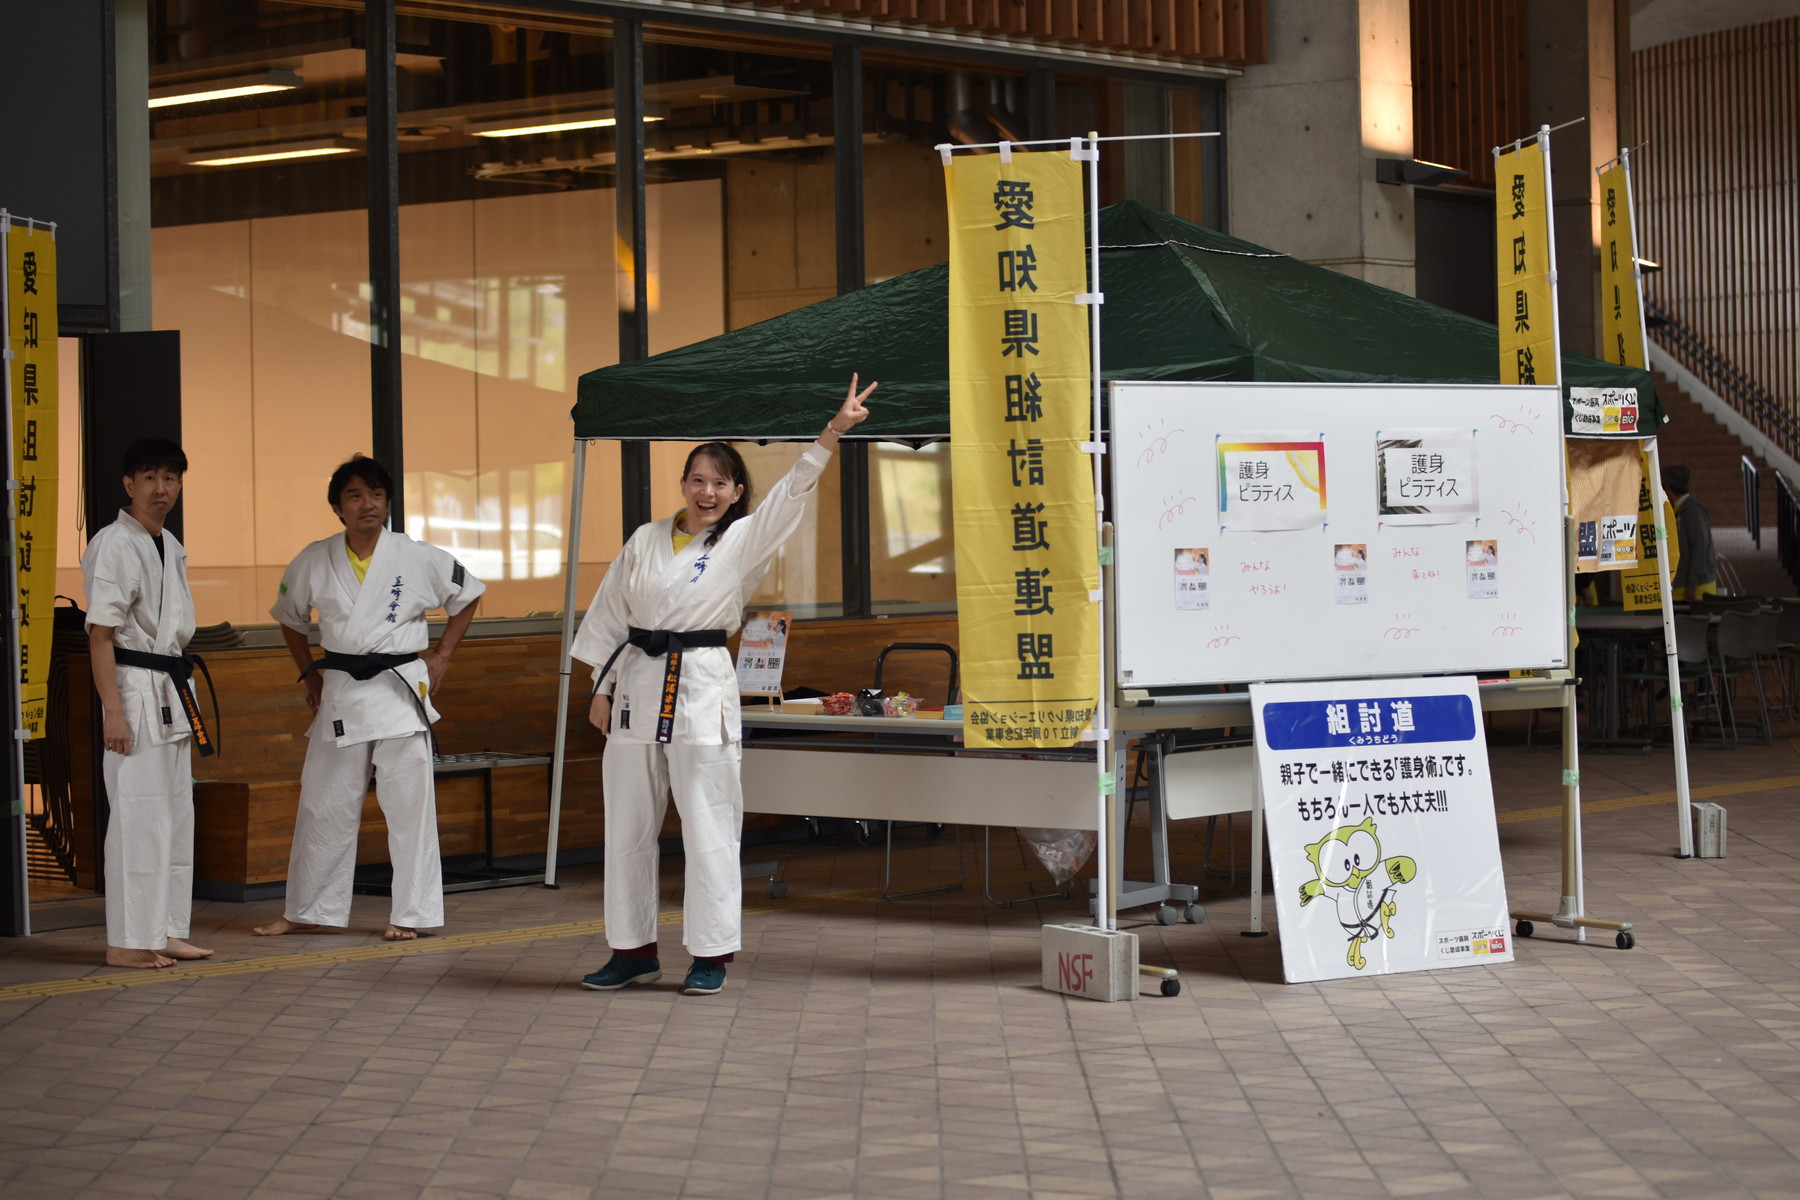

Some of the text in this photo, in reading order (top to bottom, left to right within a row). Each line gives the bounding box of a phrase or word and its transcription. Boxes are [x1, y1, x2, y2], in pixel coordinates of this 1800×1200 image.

[1239, 461, 1269, 480] 護身
[1412, 453, 1445, 475] 護身
[1238, 483, 1295, 503] ピラティス
[1399, 477, 1460, 499] ピラティス
[1392, 546, 1421, 559] みんな
[1240, 560, 1272, 574] みんな
[1325, 699, 1416, 736] 組討道
[1348, 733, 1399, 745] くみうちどう
[1279, 752, 1474, 786] 親子で一緒にできる「護身術」です。
[1297, 789, 1449, 822] もちろん一人でも大丈夫!!!
[1471, 929, 1504, 940] スポーツくじ
[1058, 952, 1094, 993] NSF
